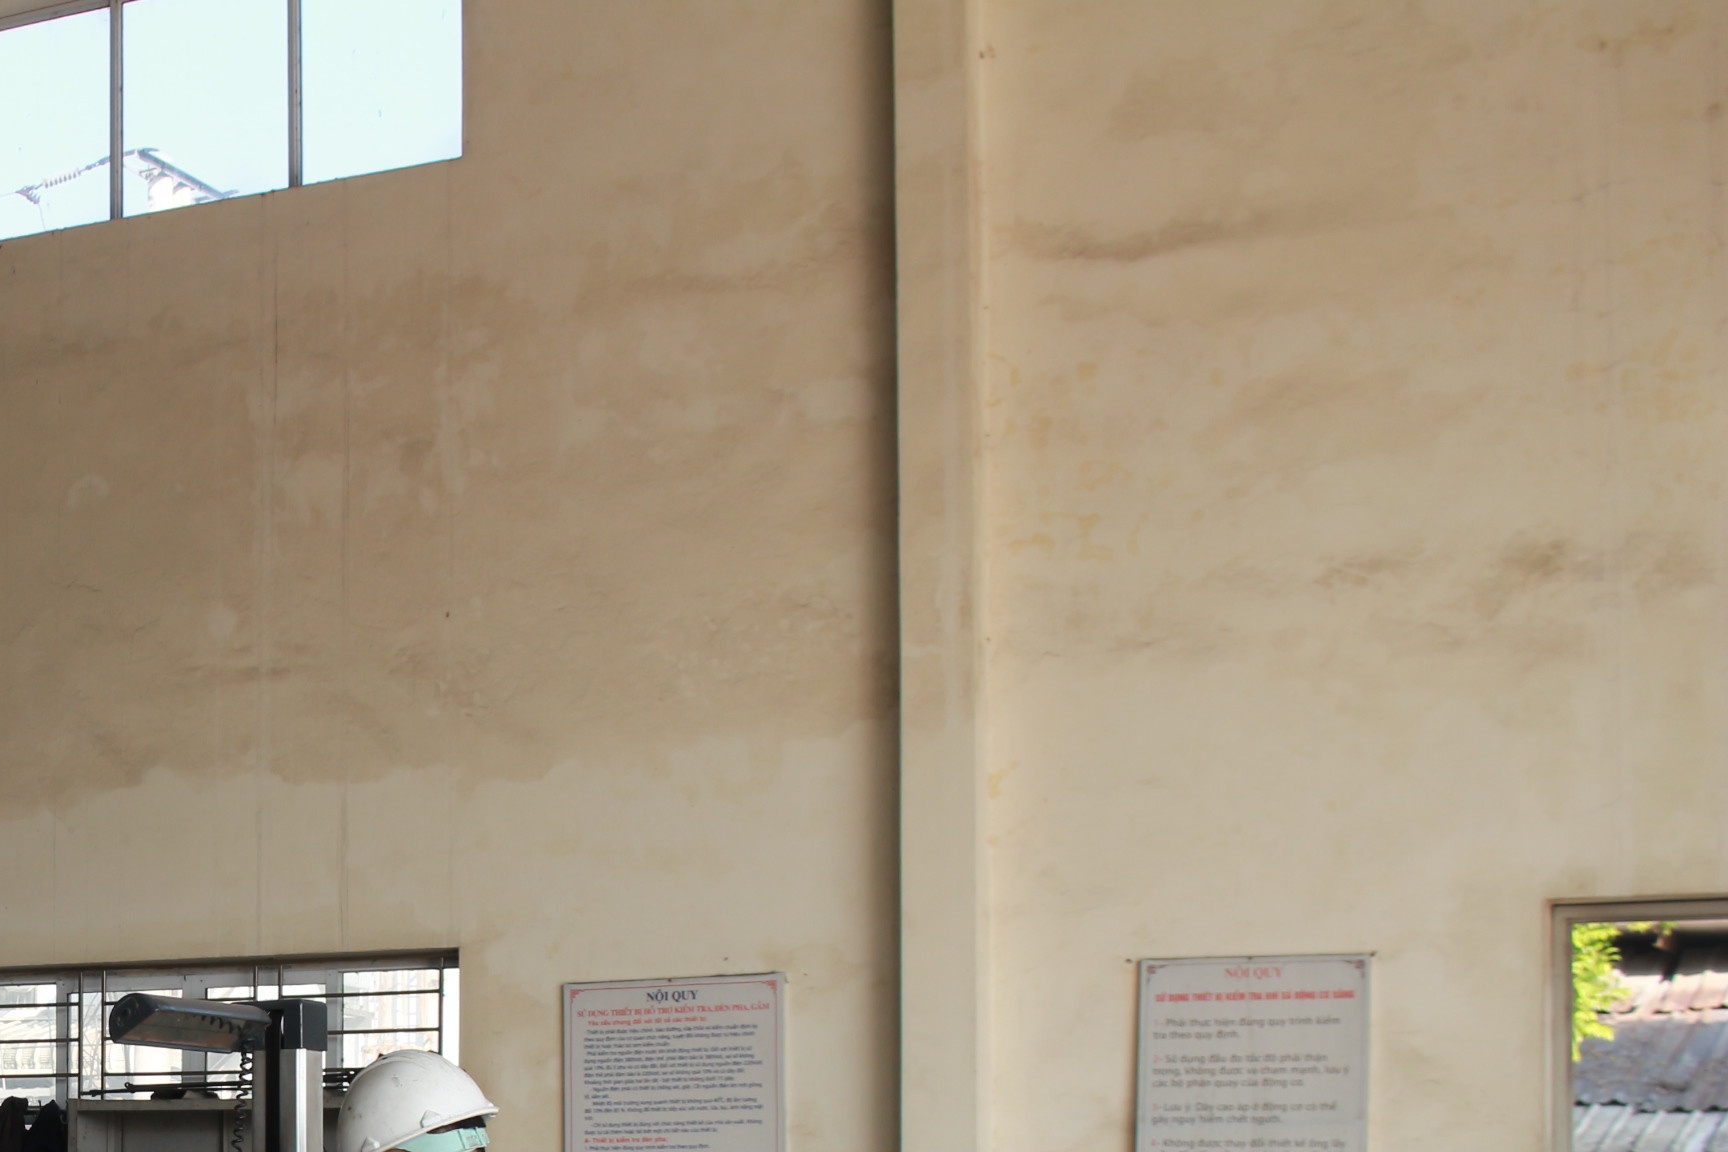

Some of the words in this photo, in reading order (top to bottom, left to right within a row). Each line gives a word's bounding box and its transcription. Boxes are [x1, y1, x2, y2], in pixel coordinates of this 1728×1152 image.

[1253, 967, 1281, 980] QUY
[646, 989, 668, 1004] NỘI
[672, 990, 698, 1003] QUY
